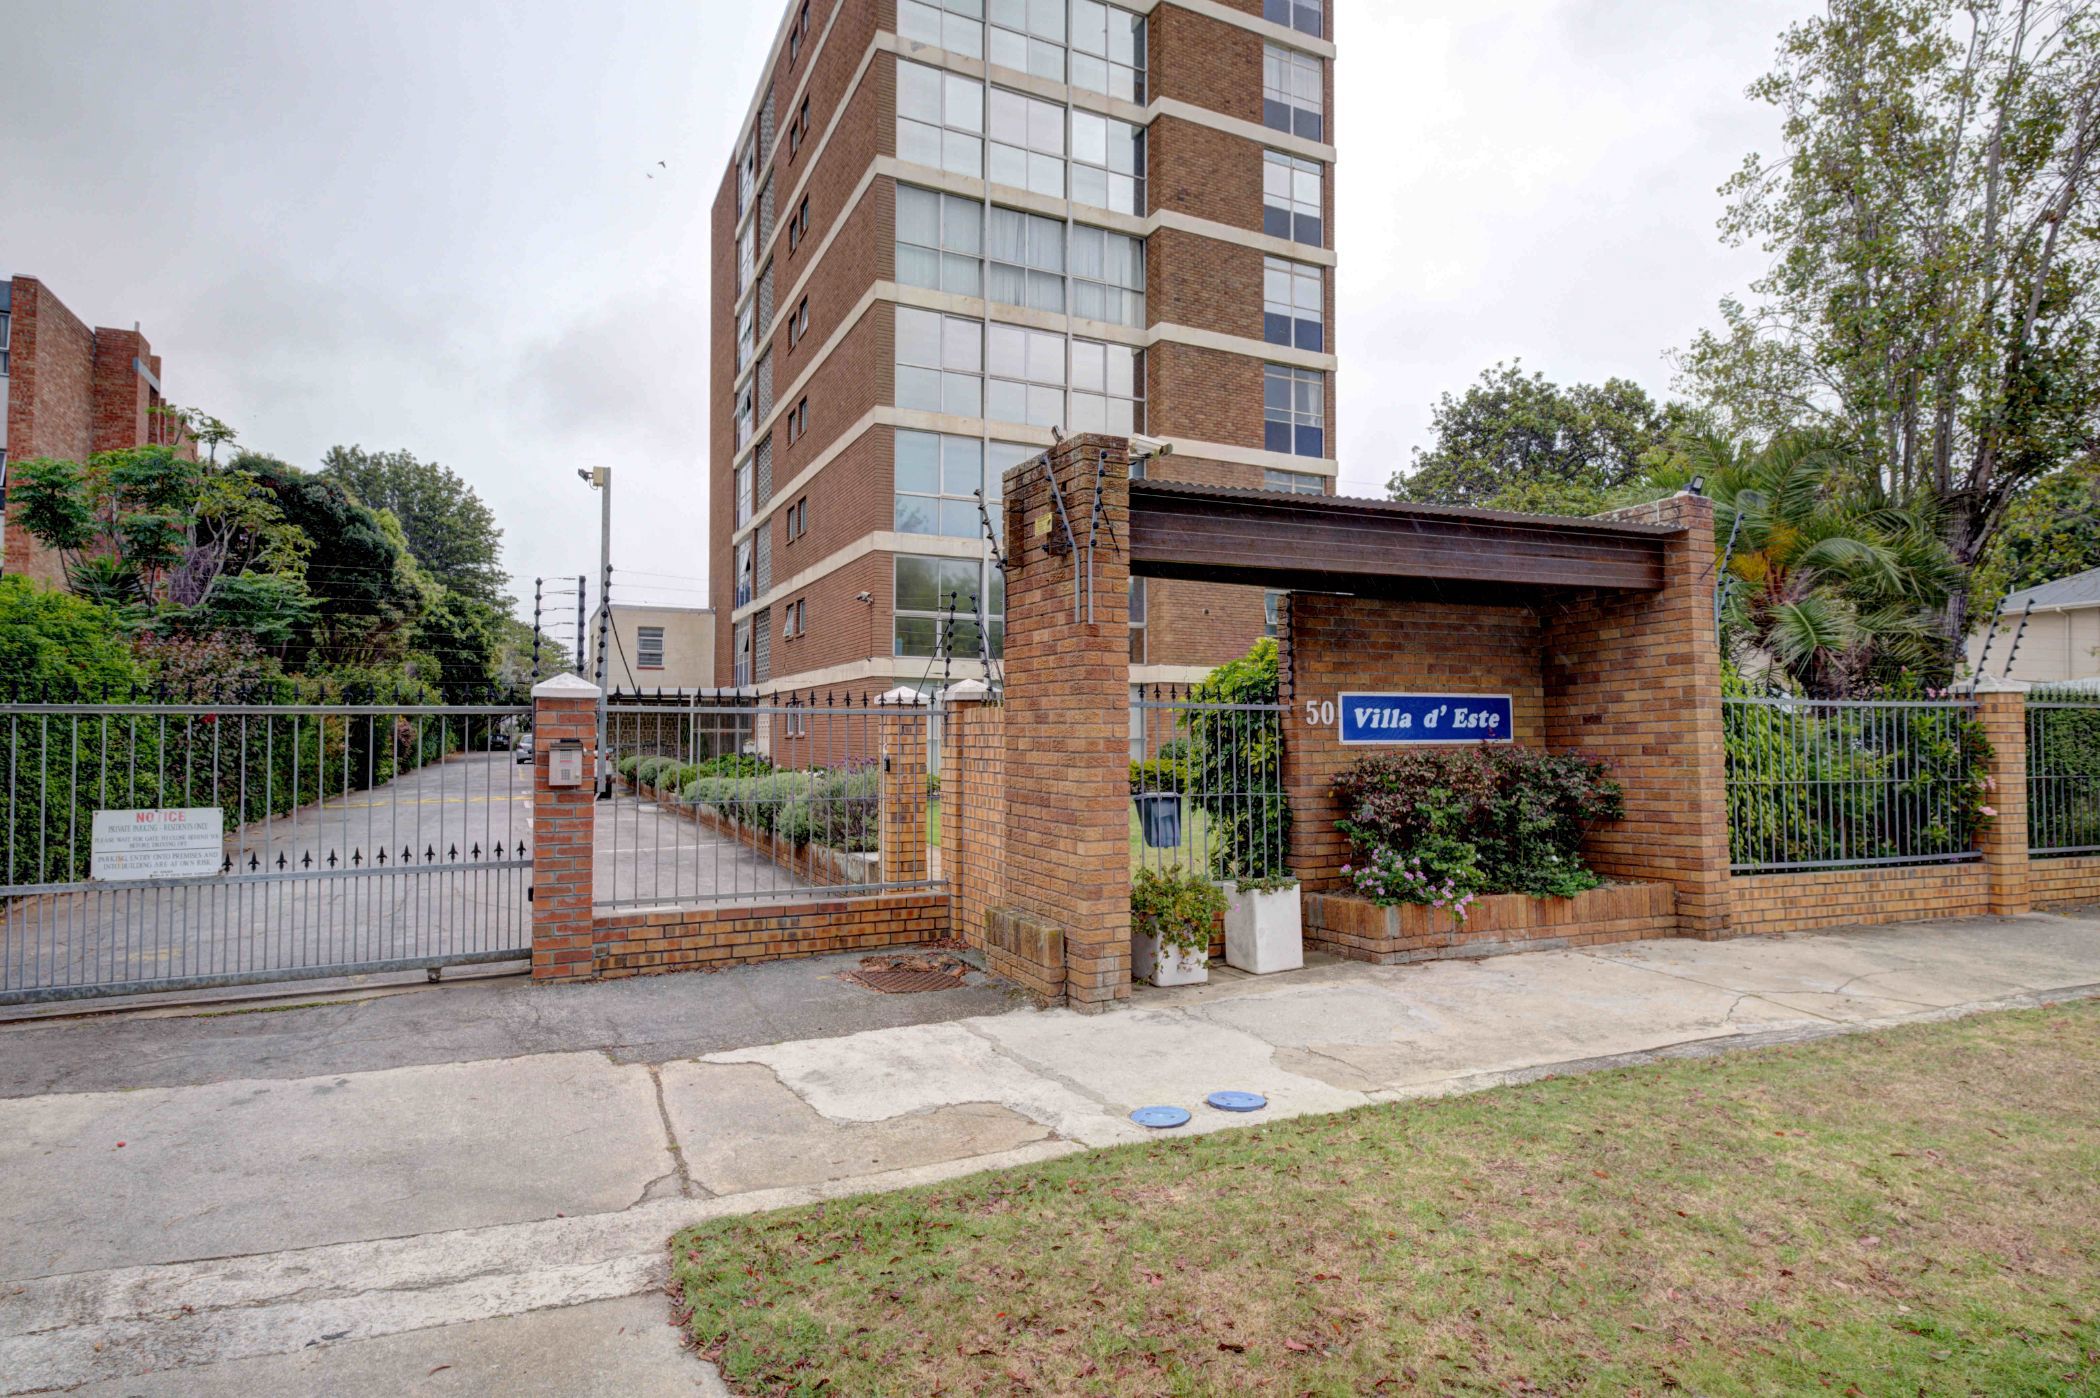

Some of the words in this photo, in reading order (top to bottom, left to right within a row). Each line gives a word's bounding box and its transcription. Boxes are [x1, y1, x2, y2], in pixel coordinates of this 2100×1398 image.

[1306, 700, 1334, 725] 50
[1354, 708, 1412, 728] Villa
[1452, 708, 1499, 728] Este
